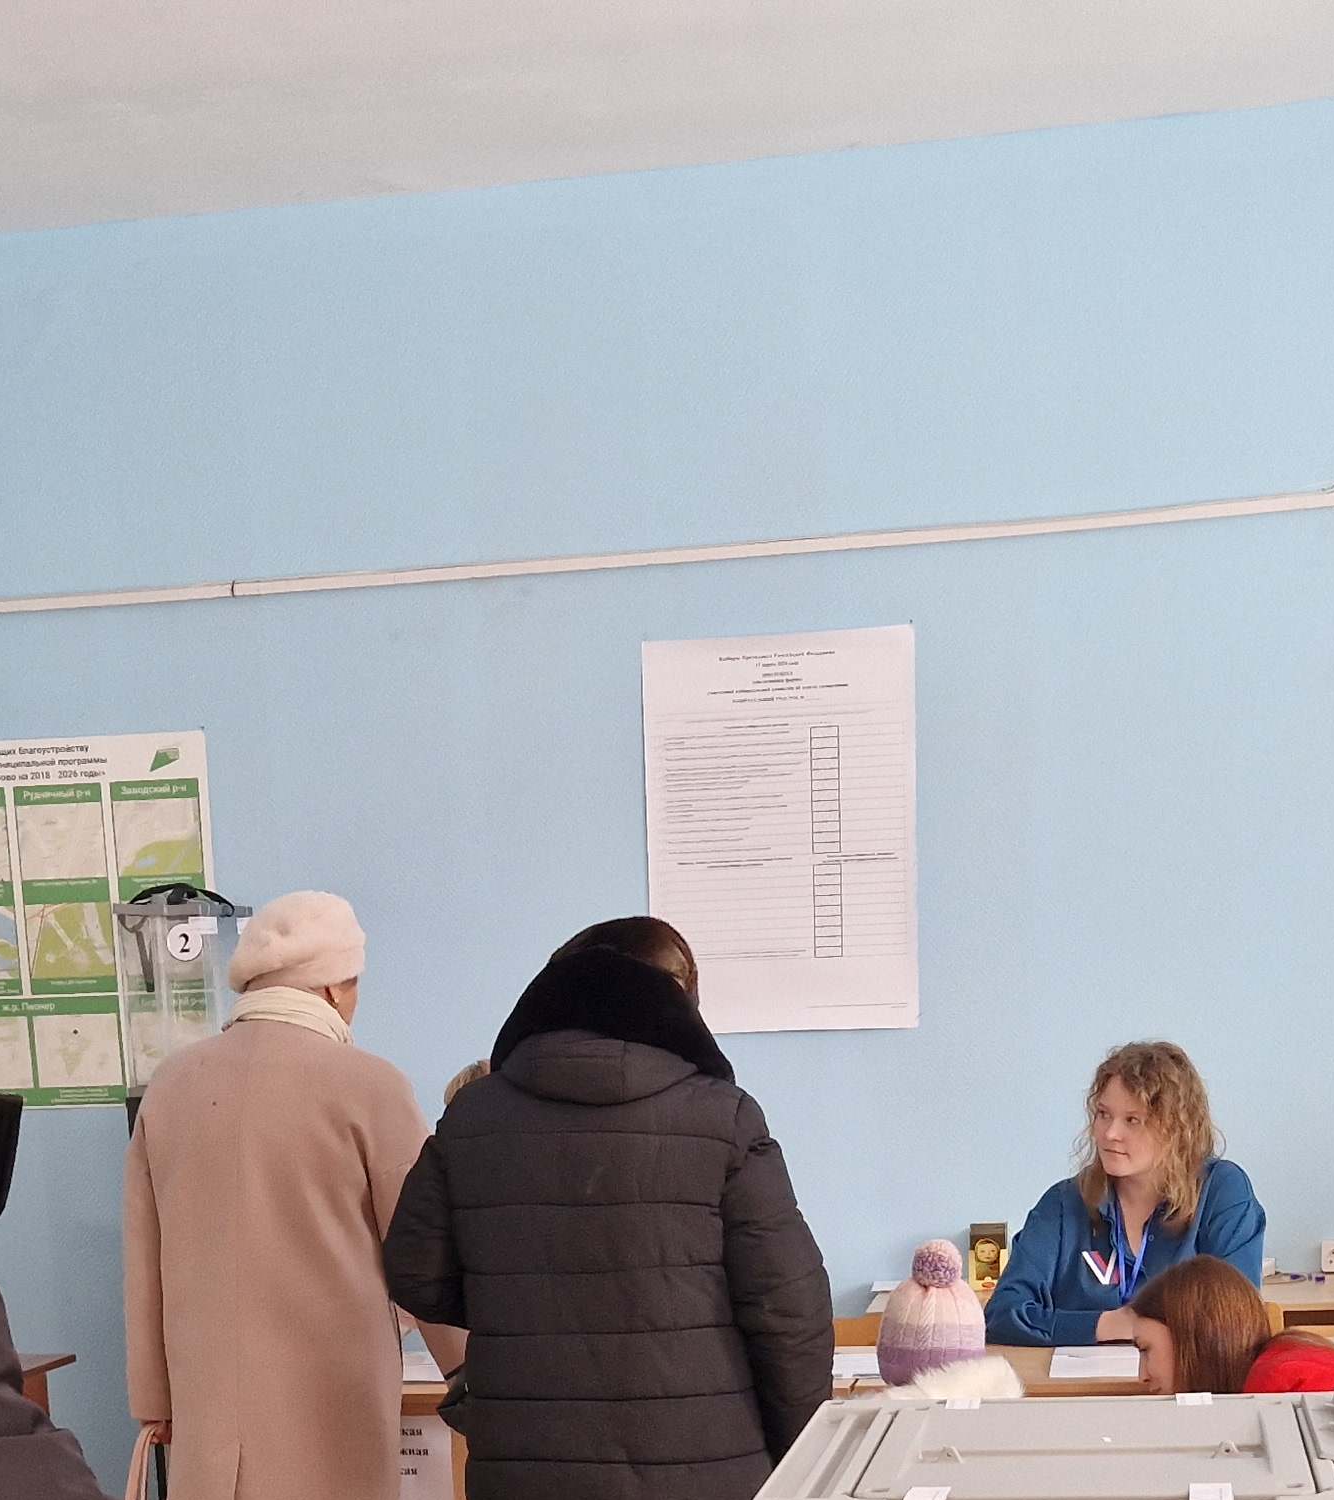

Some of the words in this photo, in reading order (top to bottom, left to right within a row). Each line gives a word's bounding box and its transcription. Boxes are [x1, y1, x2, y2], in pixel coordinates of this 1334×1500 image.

[58, 757, 107, 767] программы
[30, 771, 51, 780] 2018
[58, 770, 78, 779] 2026
[178, 933, 191, 953] 2
